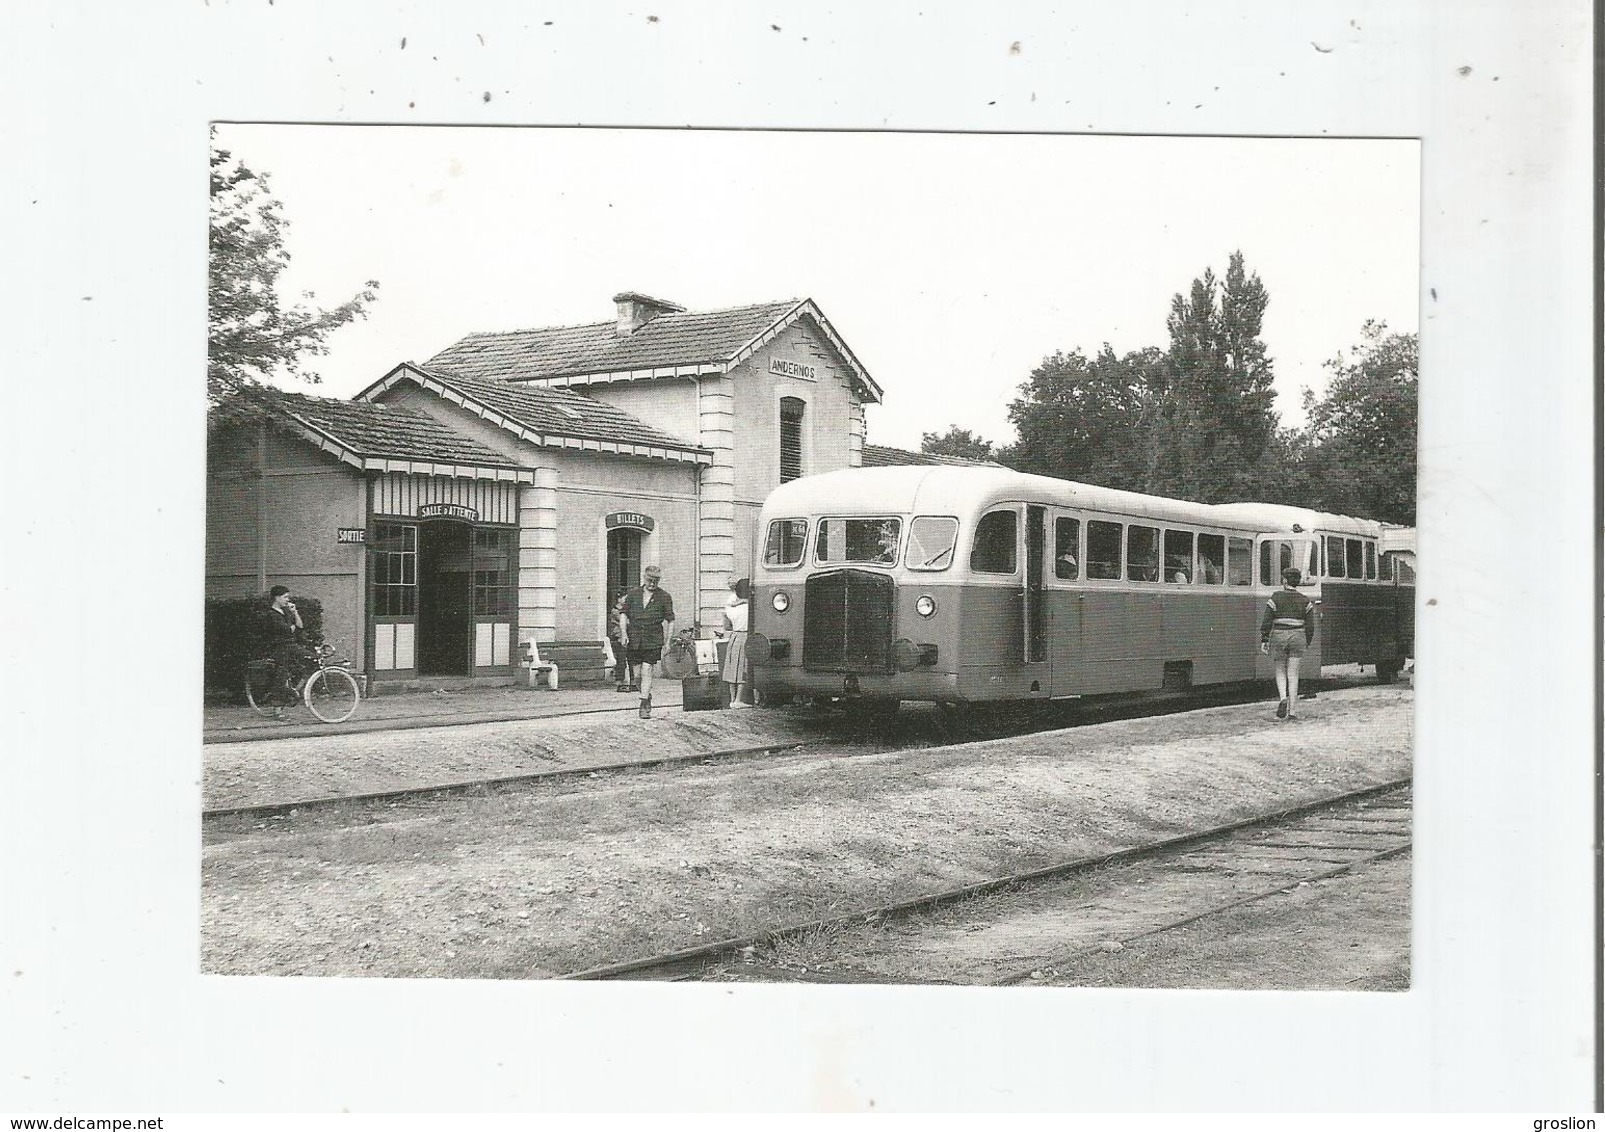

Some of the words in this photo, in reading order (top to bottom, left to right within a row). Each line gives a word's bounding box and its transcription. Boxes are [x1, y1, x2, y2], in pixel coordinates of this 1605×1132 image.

[772, 360, 815, 378] ANDERNOS
[421, 505, 442, 517] SALLE
[616, 514, 645, 525] BILLETS
[339, 530, 365, 541] SORTIE
